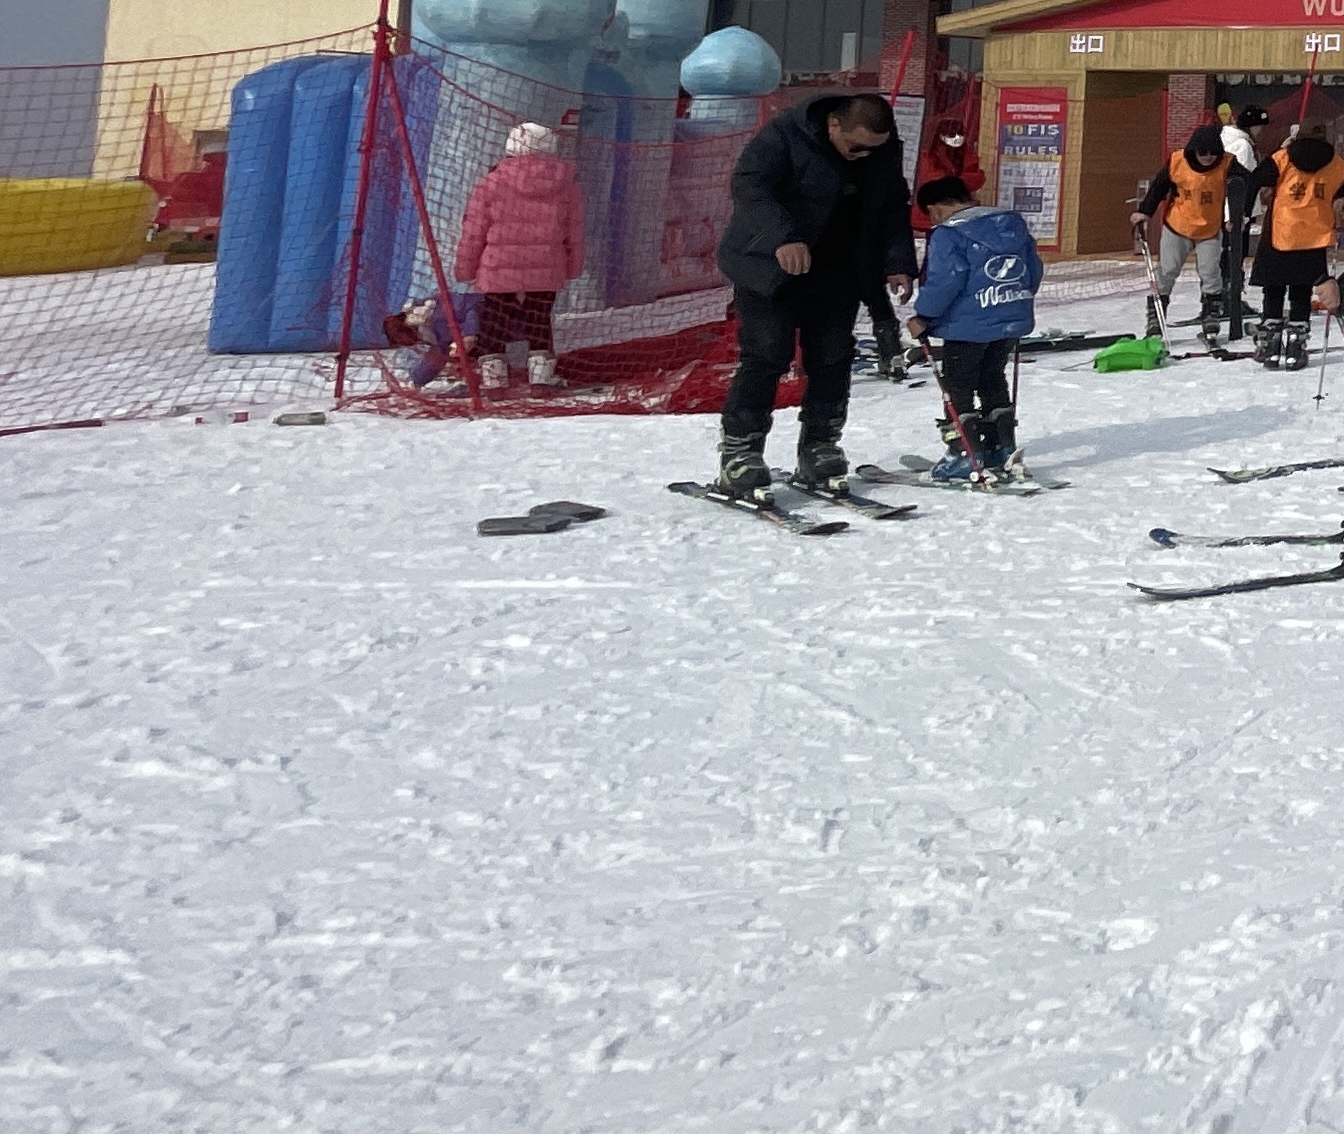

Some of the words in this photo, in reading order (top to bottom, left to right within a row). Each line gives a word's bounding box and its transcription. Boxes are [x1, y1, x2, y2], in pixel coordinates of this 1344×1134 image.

[1069, 33, 1104, 53] 出口
[1304, 32, 1341, 53] 出口
[1027, 123, 1060, 136] FIS
[1003, 145, 1059, 156] RULES
